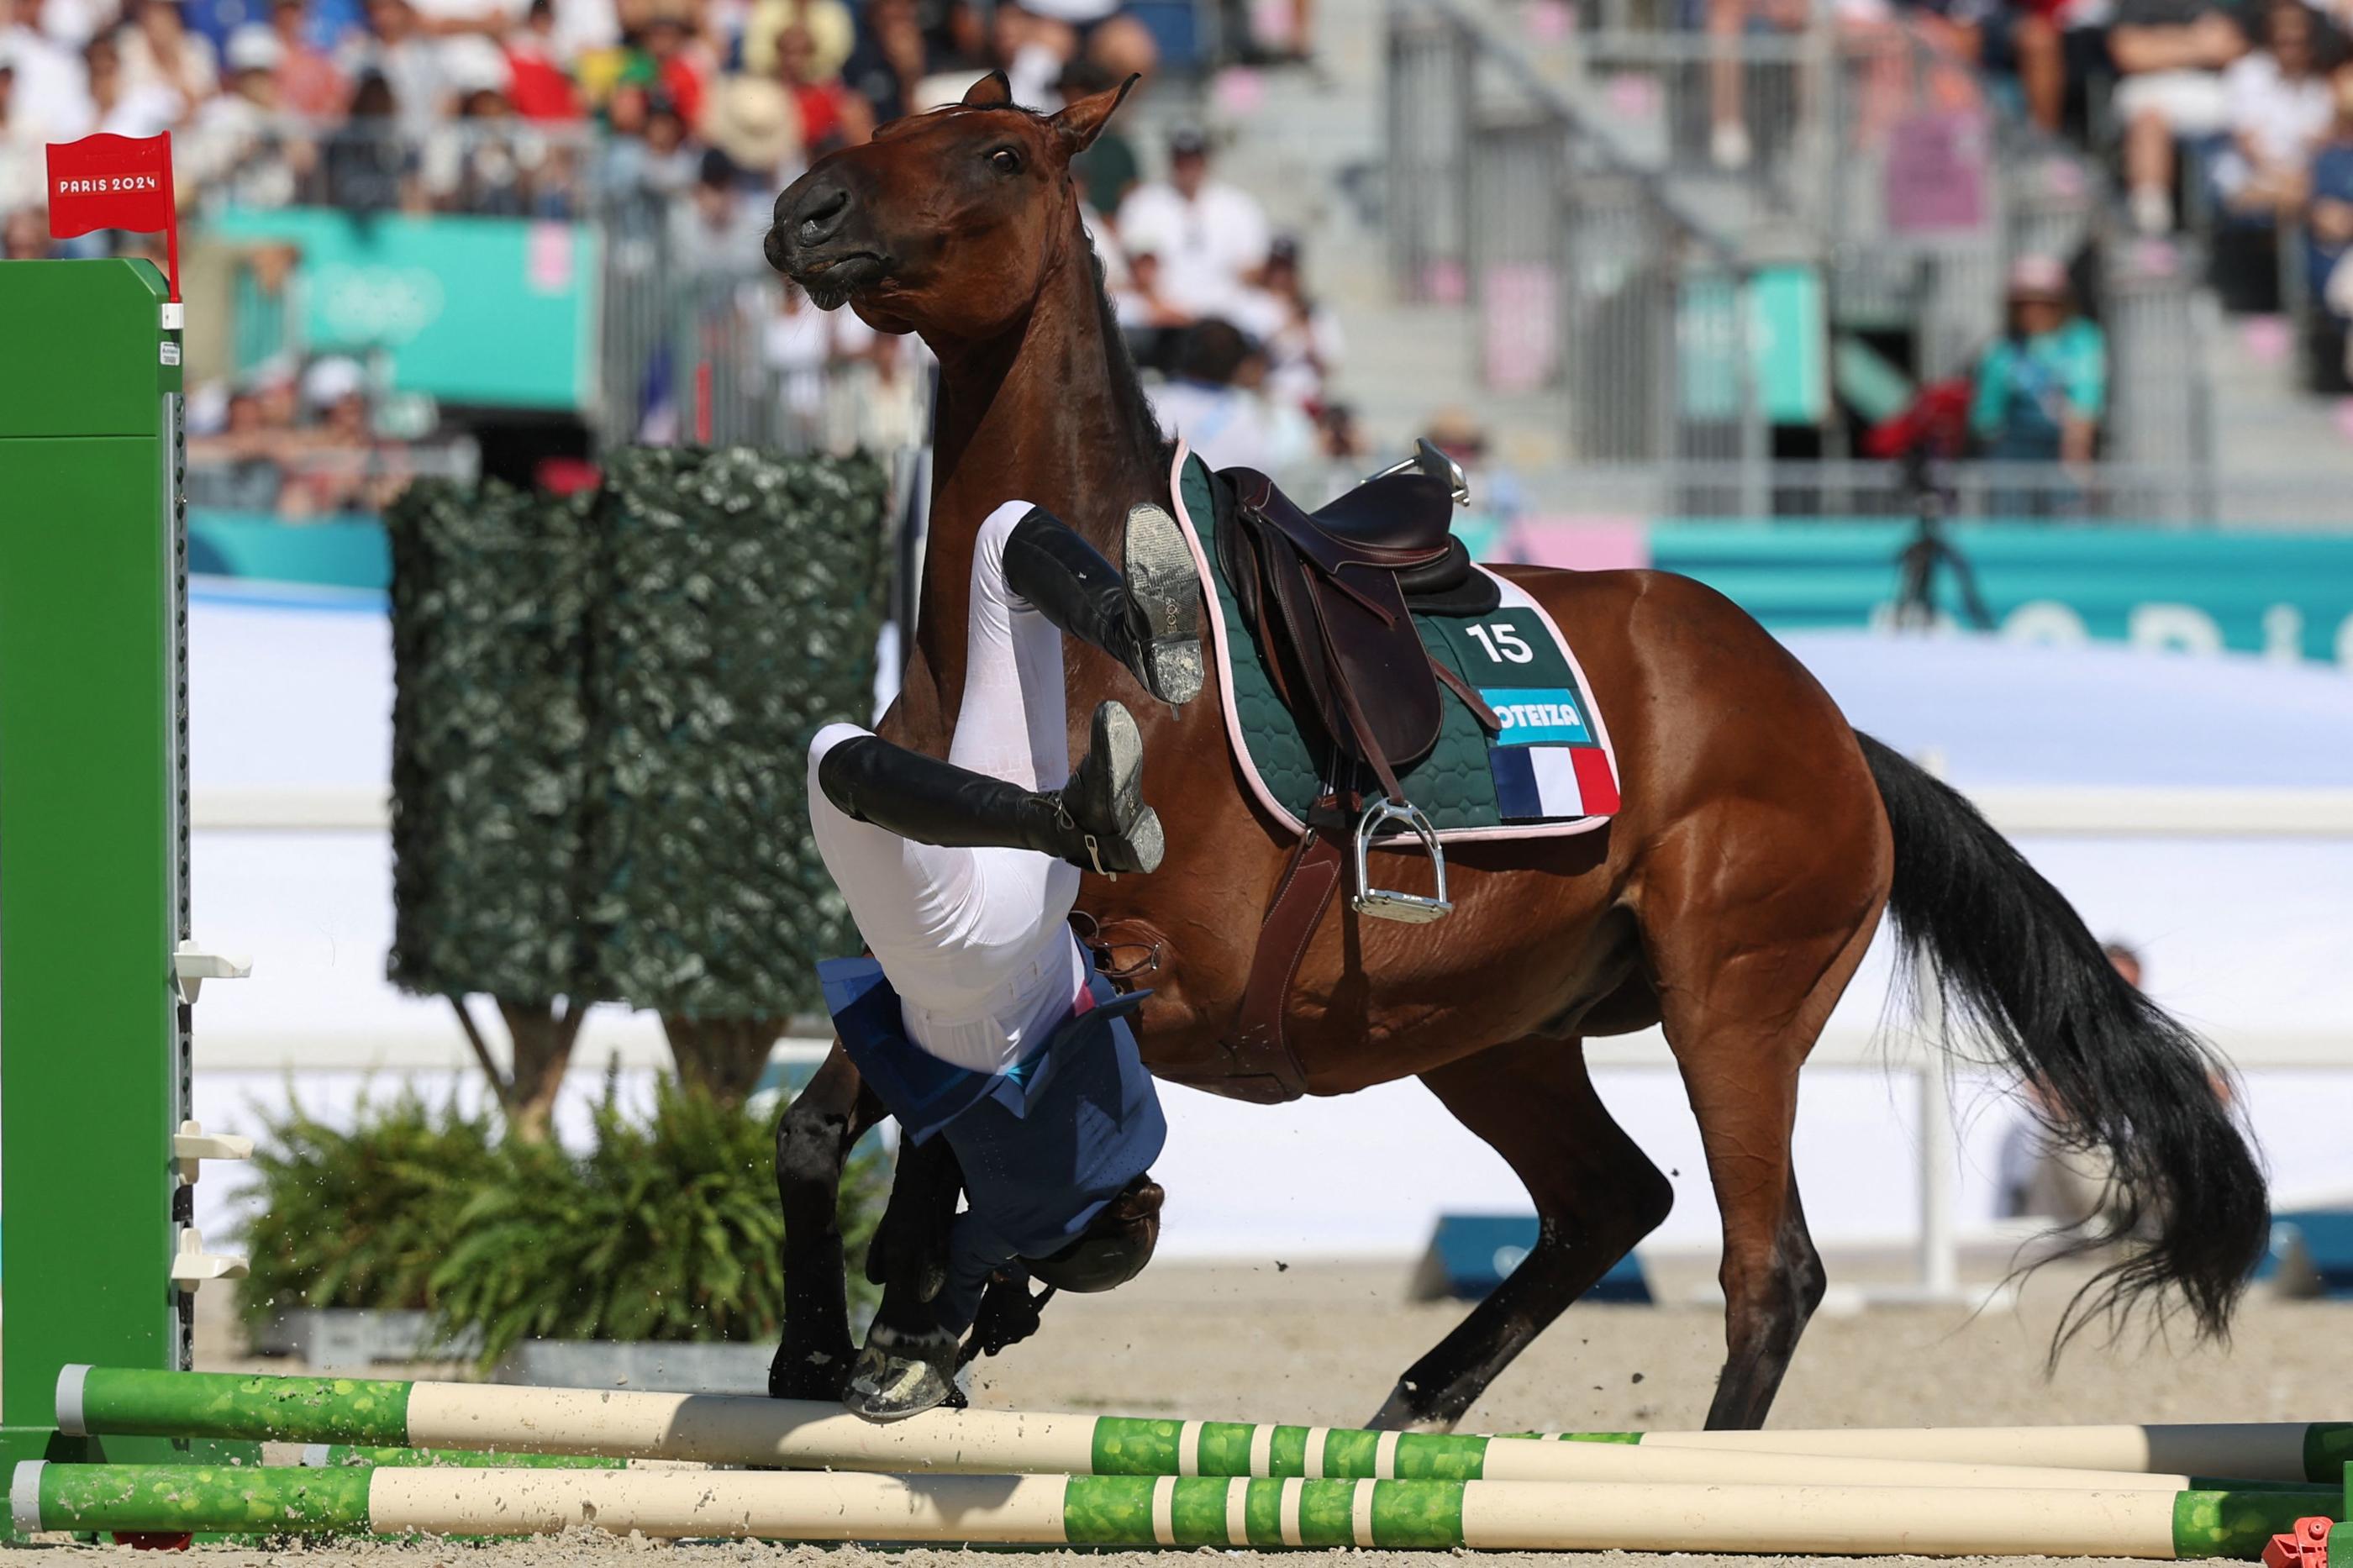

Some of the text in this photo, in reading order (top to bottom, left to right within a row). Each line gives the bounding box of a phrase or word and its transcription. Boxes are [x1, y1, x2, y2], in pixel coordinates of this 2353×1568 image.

[60, 176, 155, 193] PARIS 2024
[1465, 623, 1534, 664] 15
[1492, 703, 1581, 729] OTEIZA
